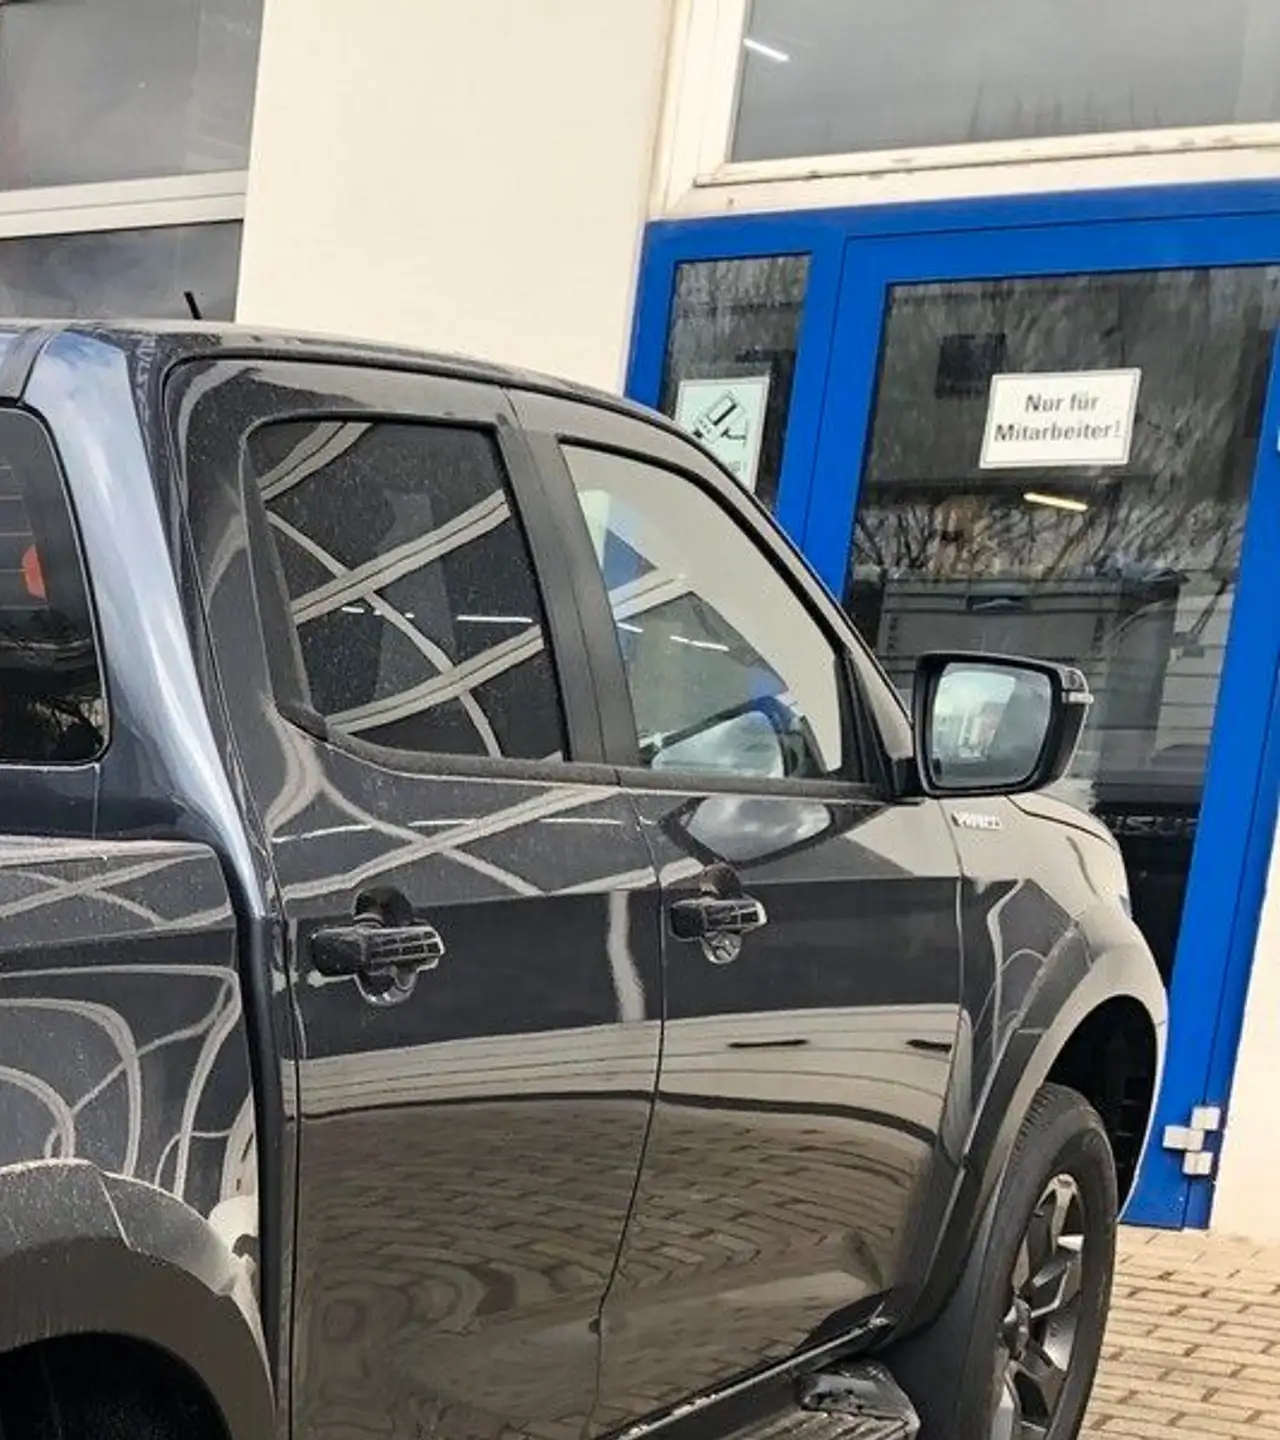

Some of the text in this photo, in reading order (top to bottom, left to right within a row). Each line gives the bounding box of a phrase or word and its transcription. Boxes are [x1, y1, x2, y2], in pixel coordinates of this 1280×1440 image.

[1024, 390, 1100, 413] Nur für
[994, 420, 1123, 442] Mitarbeiter!
